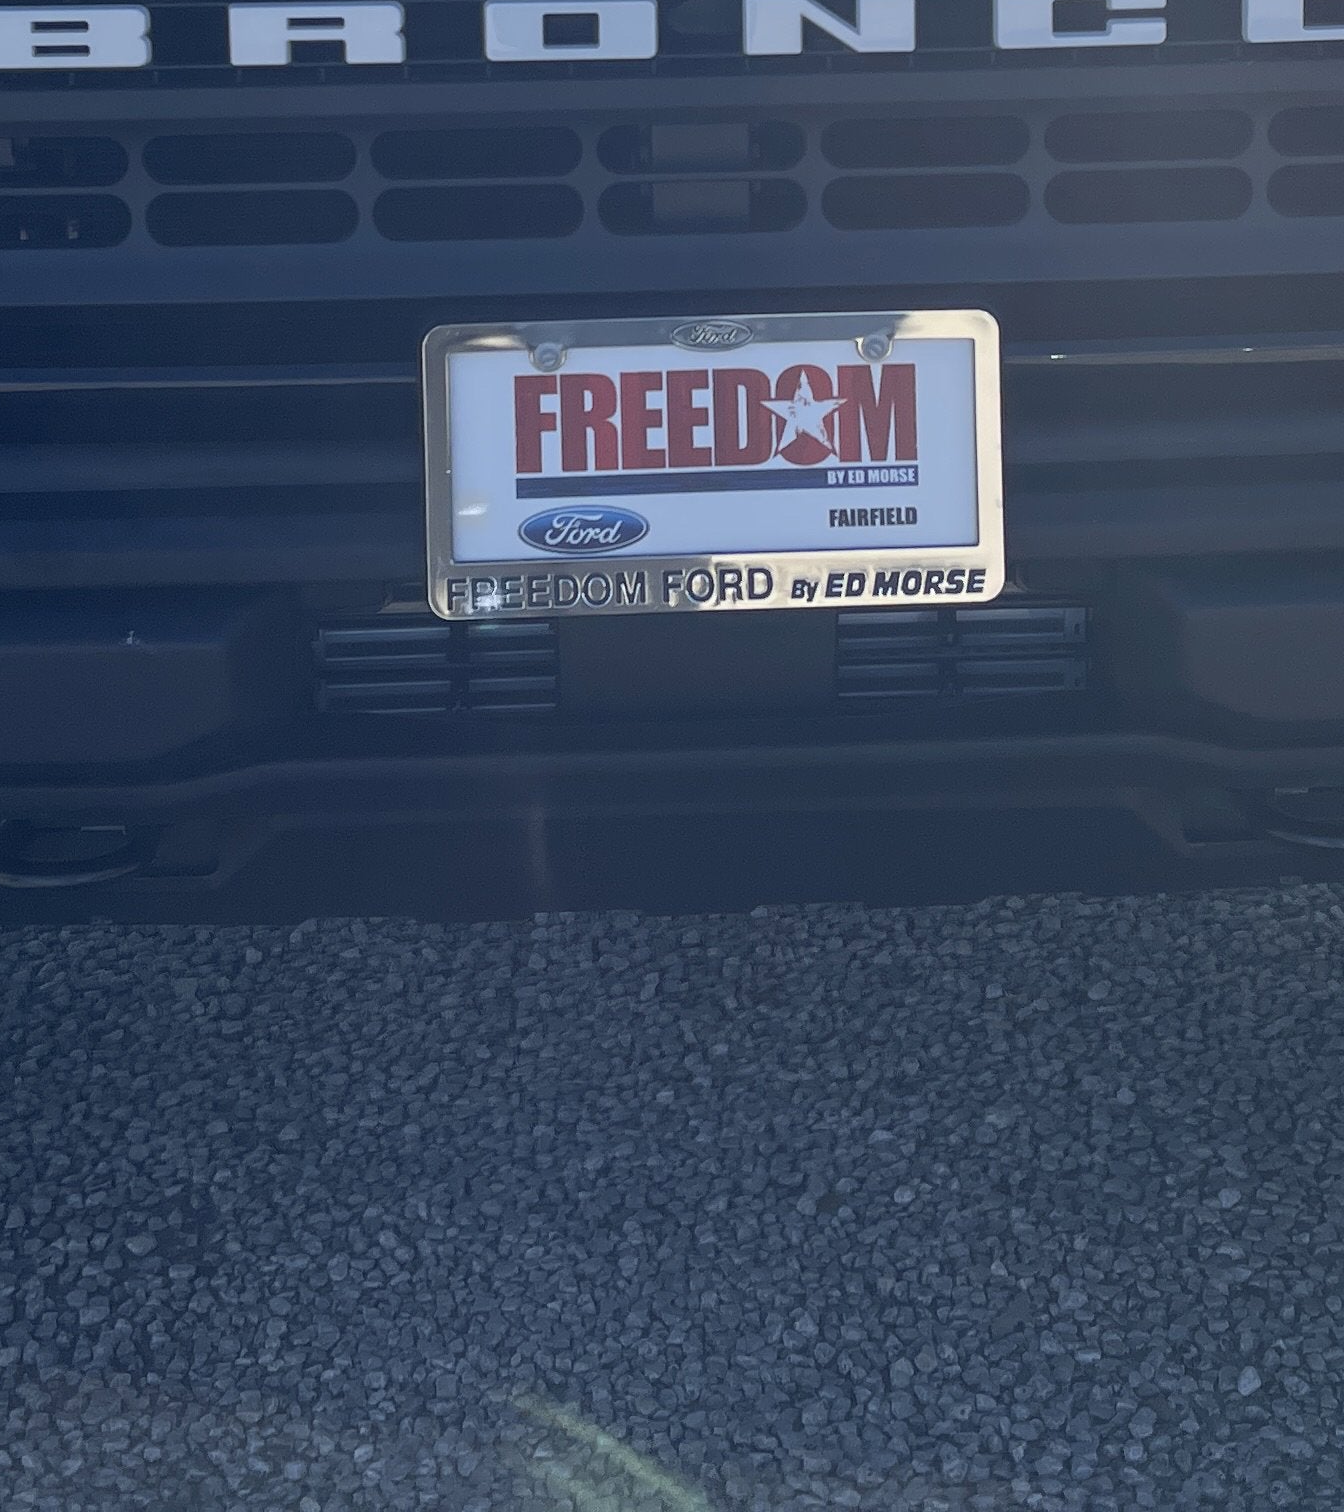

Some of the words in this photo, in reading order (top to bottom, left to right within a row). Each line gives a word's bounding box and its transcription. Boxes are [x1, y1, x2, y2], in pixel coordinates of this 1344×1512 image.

[689, 325, 737, 345] Ford
[514, 364, 918, 474] FREEDOM
[827, 469, 846, 485] BY
[848, 470, 865, 484] ED
[868, 467, 916, 484] MORSE
[544, 512, 624, 546] Ford
[829, 506, 918, 528] FAIRFIELD
[446, 570, 648, 612] FREEDOM
[662, 566, 774, 606] FORD
[825, 571, 867, 598] ED
[872, 568, 986, 597] MORSE
